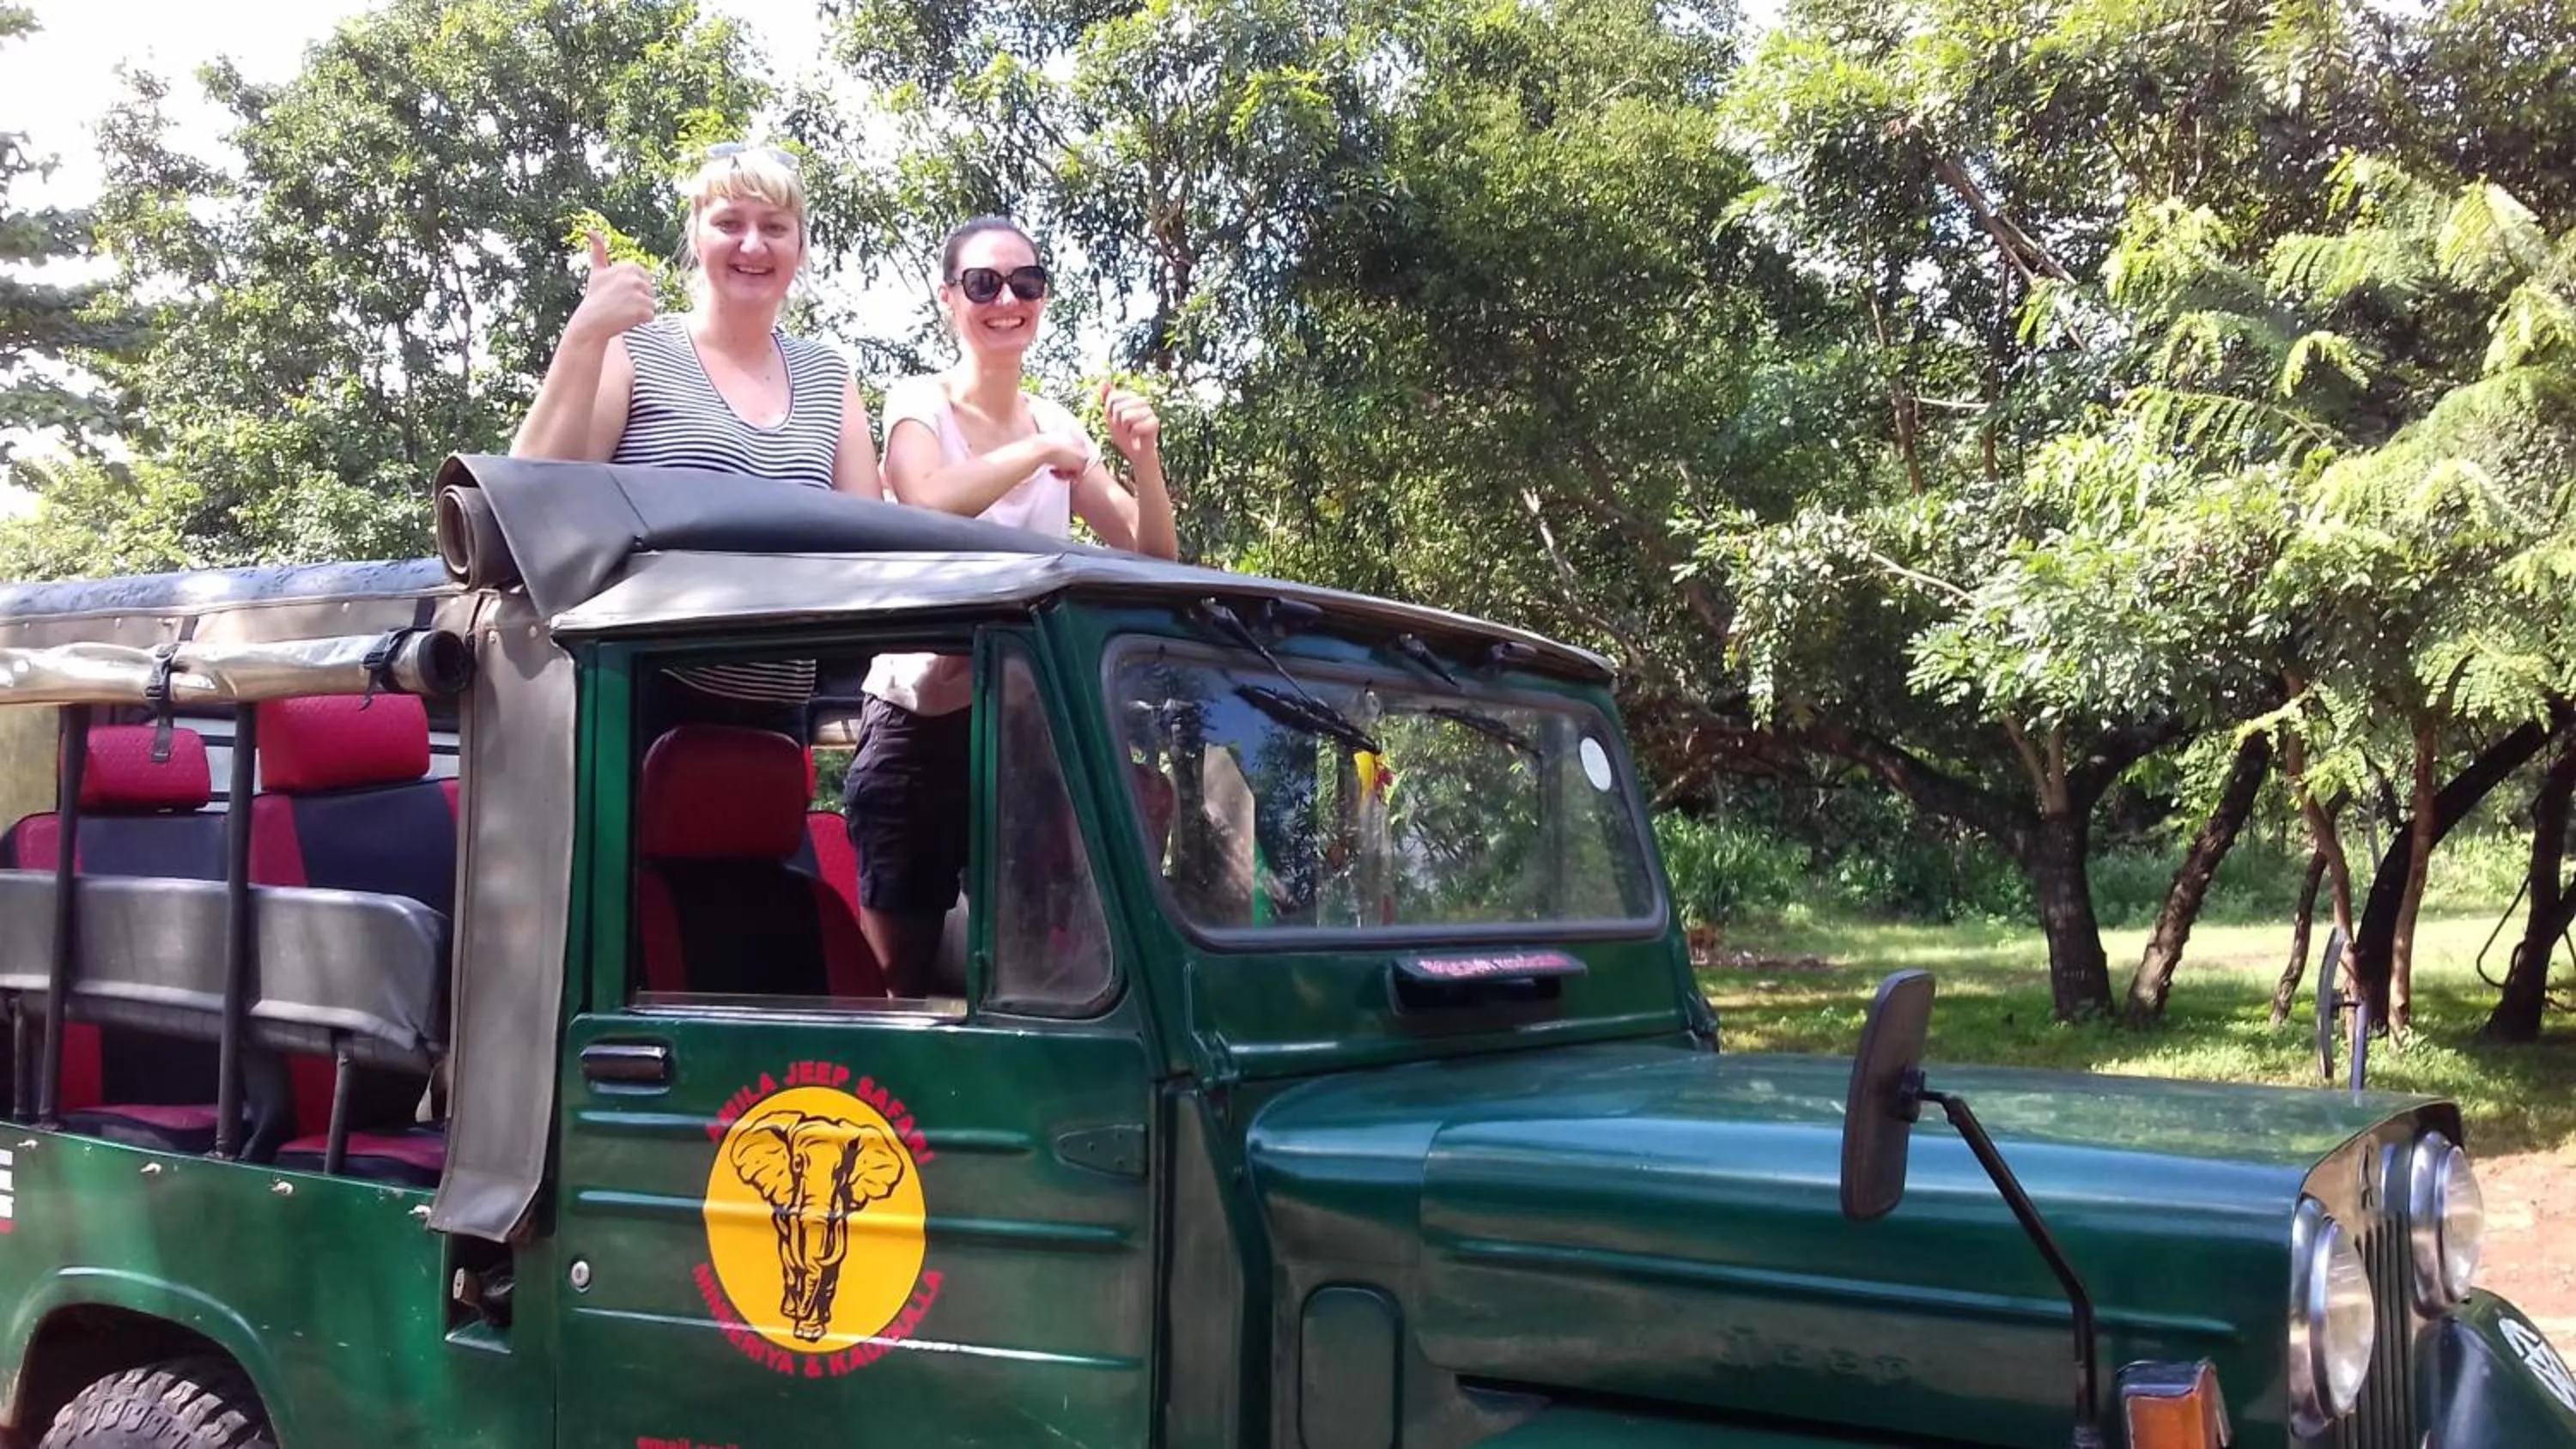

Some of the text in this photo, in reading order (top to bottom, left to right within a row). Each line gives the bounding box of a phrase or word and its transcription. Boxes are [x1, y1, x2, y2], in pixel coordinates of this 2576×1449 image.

[783, 1061, 850, 1087] JEEP
[857, 1076, 936, 1165] SAFARI
[804, 1355, 824, 1379] &
